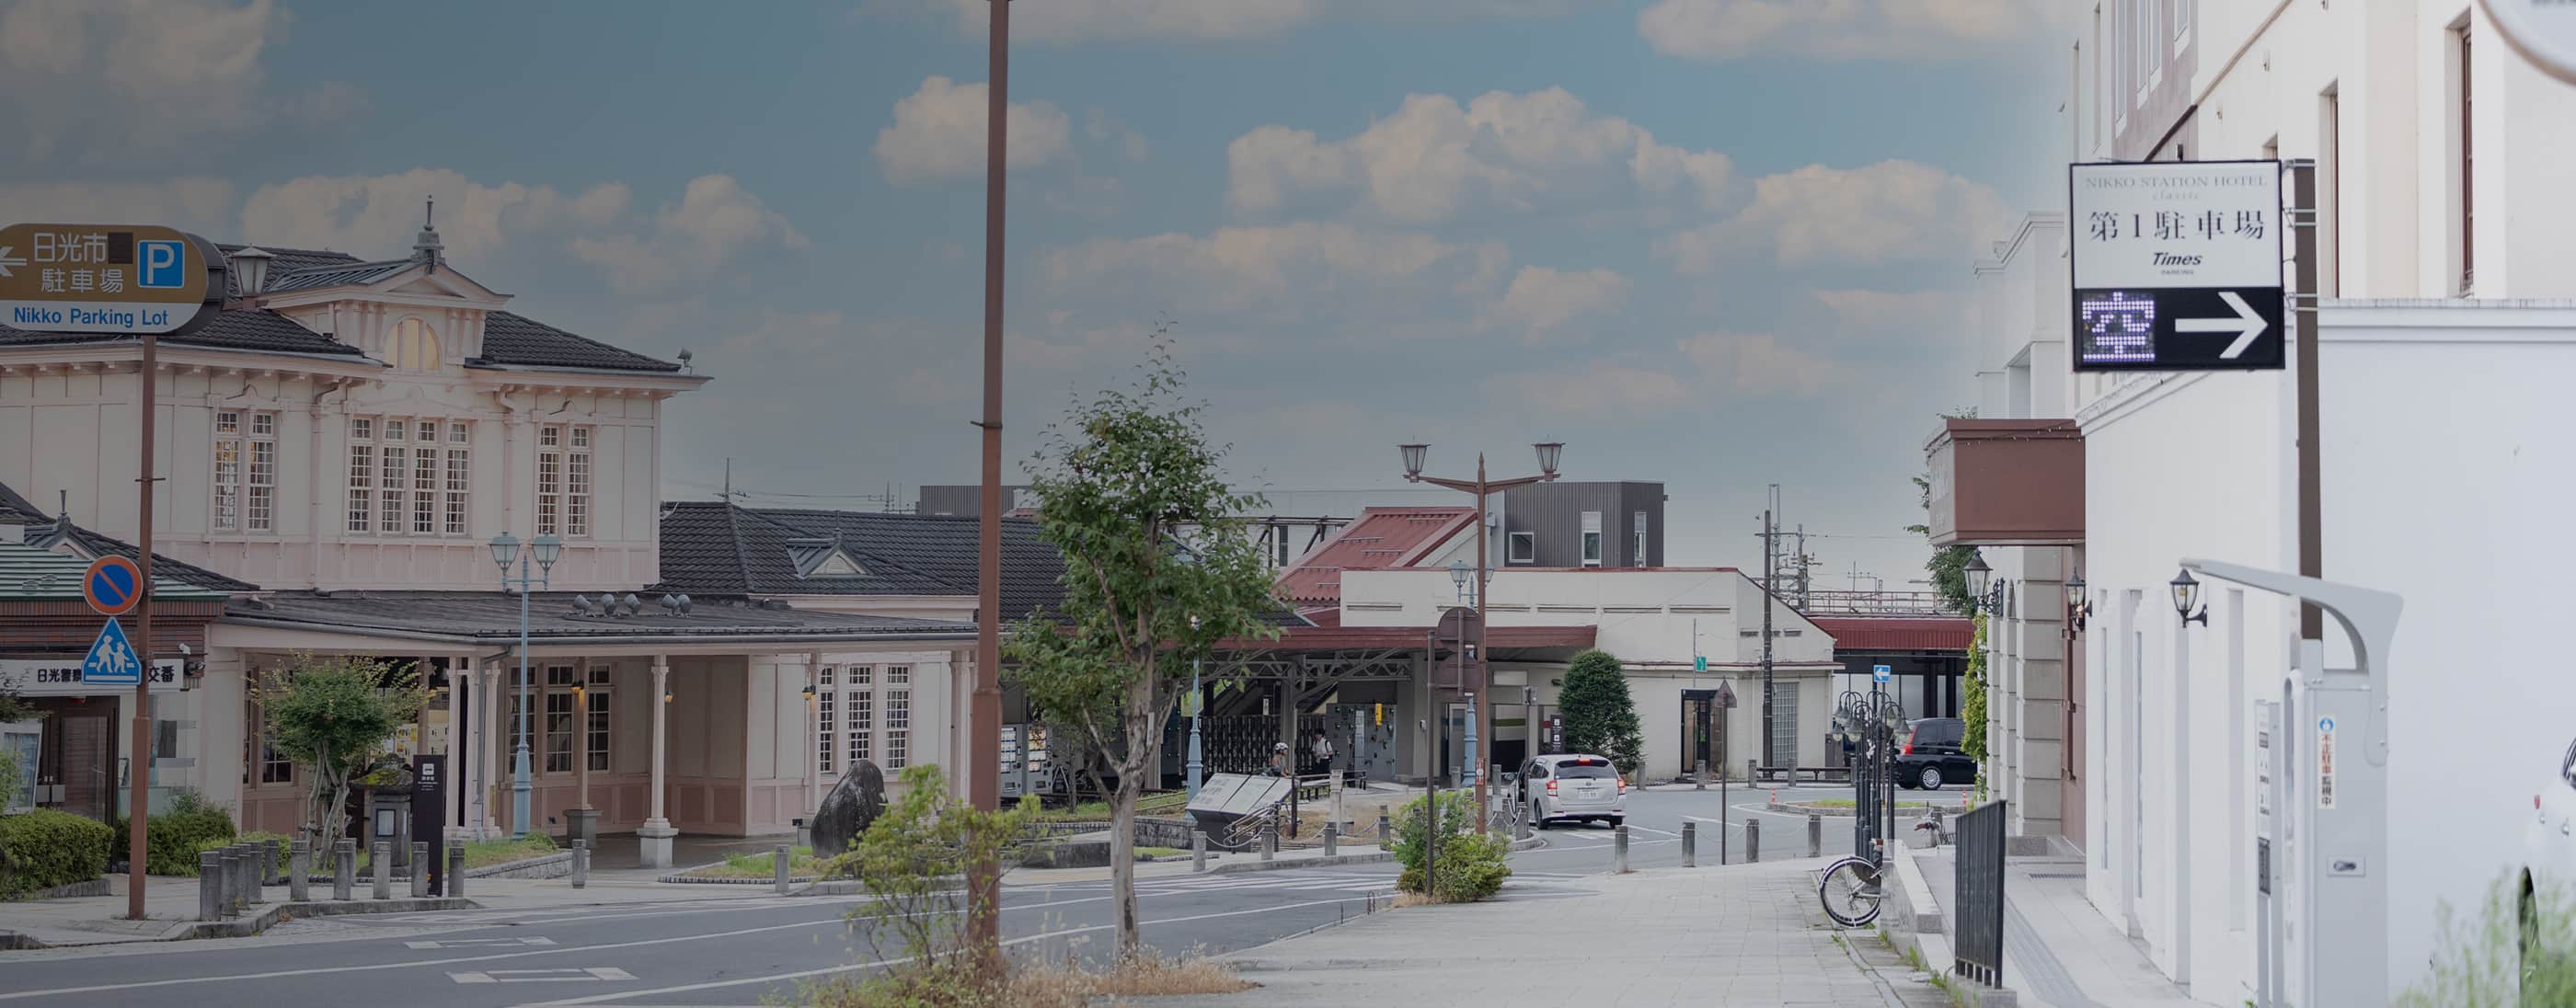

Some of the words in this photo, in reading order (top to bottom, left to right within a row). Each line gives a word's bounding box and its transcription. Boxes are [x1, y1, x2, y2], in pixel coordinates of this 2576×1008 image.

[2086, 178, 2135, 189] NIKKO
[2141, 177, 2209, 188] STATION
[2214, 176, 2268, 187] HOTEL
[146, 244, 175, 285] P
[2153, 252, 2202, 266] Times
[40, 268, 125, 293] 駐車場
[14, 306, 63, 324] Nikko
[70, 308, 133, 328] Parking
[142, 309, 168, 326] Lot
[2082, 292, 2156, 362] 空
[148, 666, 174, 682] 交番
